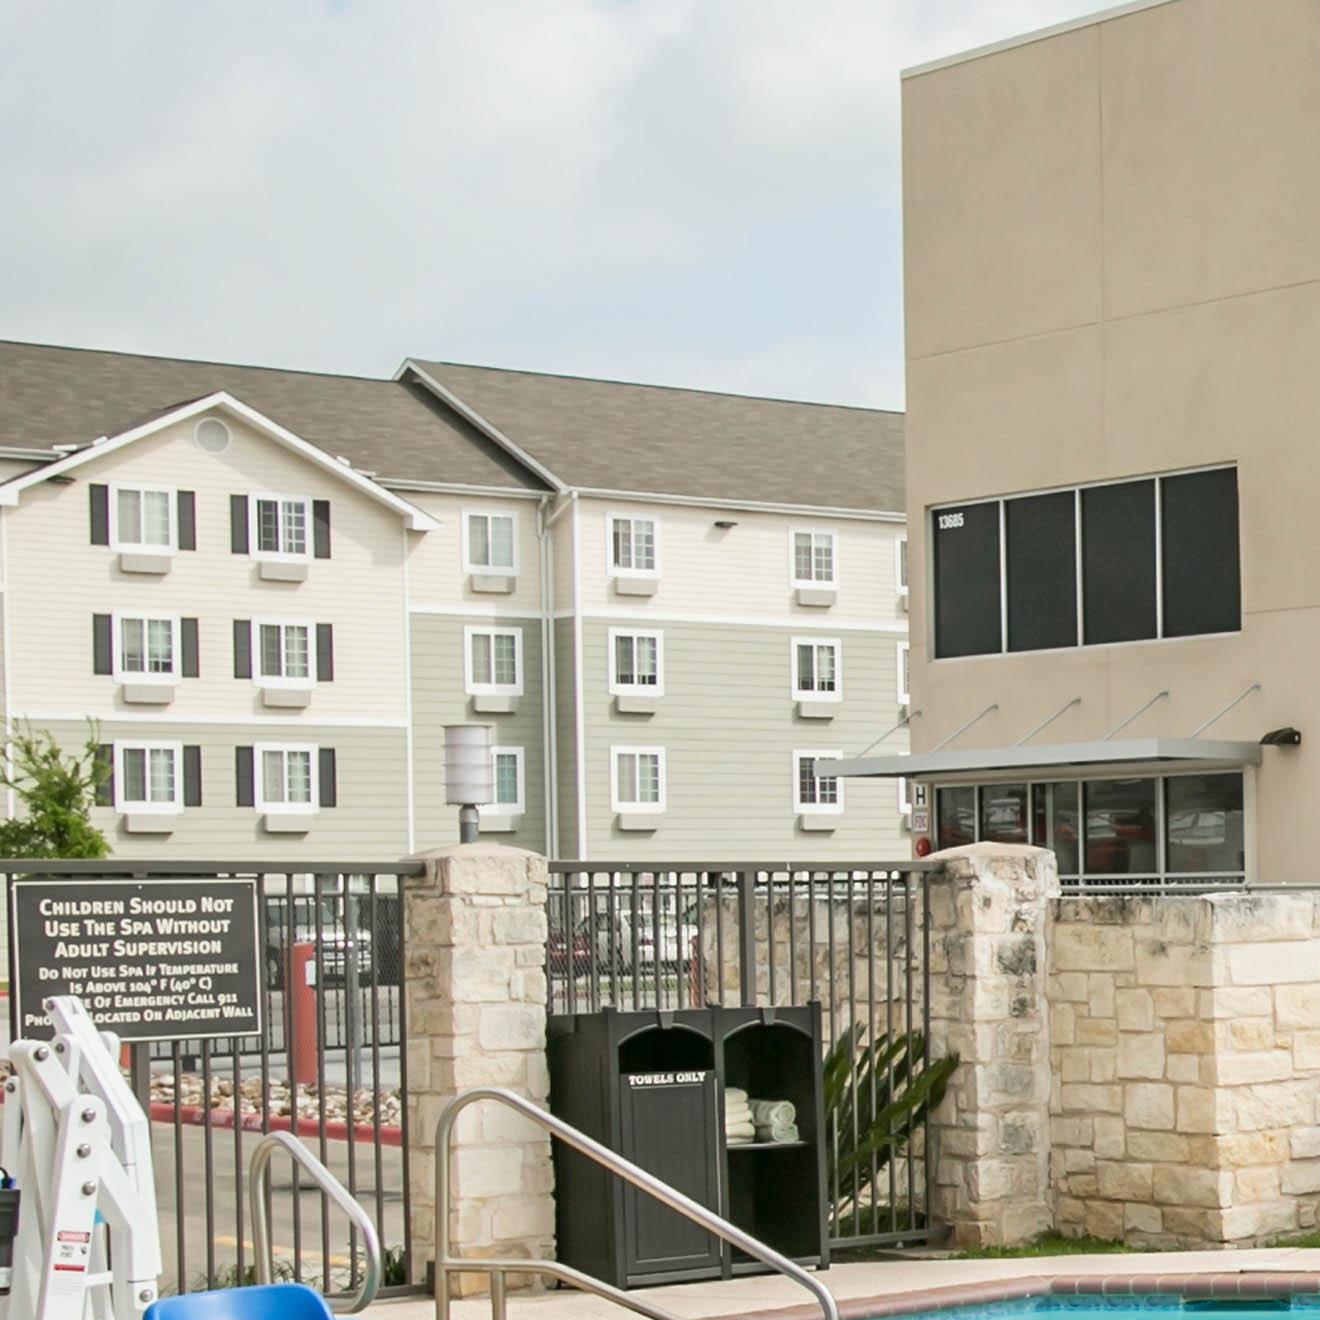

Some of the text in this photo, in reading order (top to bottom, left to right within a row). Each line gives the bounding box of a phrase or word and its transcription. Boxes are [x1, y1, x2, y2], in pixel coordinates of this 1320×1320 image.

[915, 786, 926, 805] H
[39, 896, 234, 916] CHILDREN SHOULD NOT
[44, 918, 231, 937] USE THE SPA WITHOUT
[54, 939, 222, 958] ADULT SUPERVISION
[39, 967, 59, 979] DO
[62, 966, 89, 978] NOT
[91, 966, 116, 978] USE
[119, 964, 144, 977] SPA
[159, 963, 239, 975] TEMPERATURE
[70, 981, 83, 994] IS
[86, 981, 127, 993] ABOVE
[114, 994, 185, 1007] EMERGENCY
[187, 991, 215, 1004] CALL
[143, 1009, 162, 1022] ON
[165, 1007, 220, 1021] ADJACENT
[222, 1005, 254, 1018] WALL
[628, 1071, 706, 1086] TOWELS ONLY
